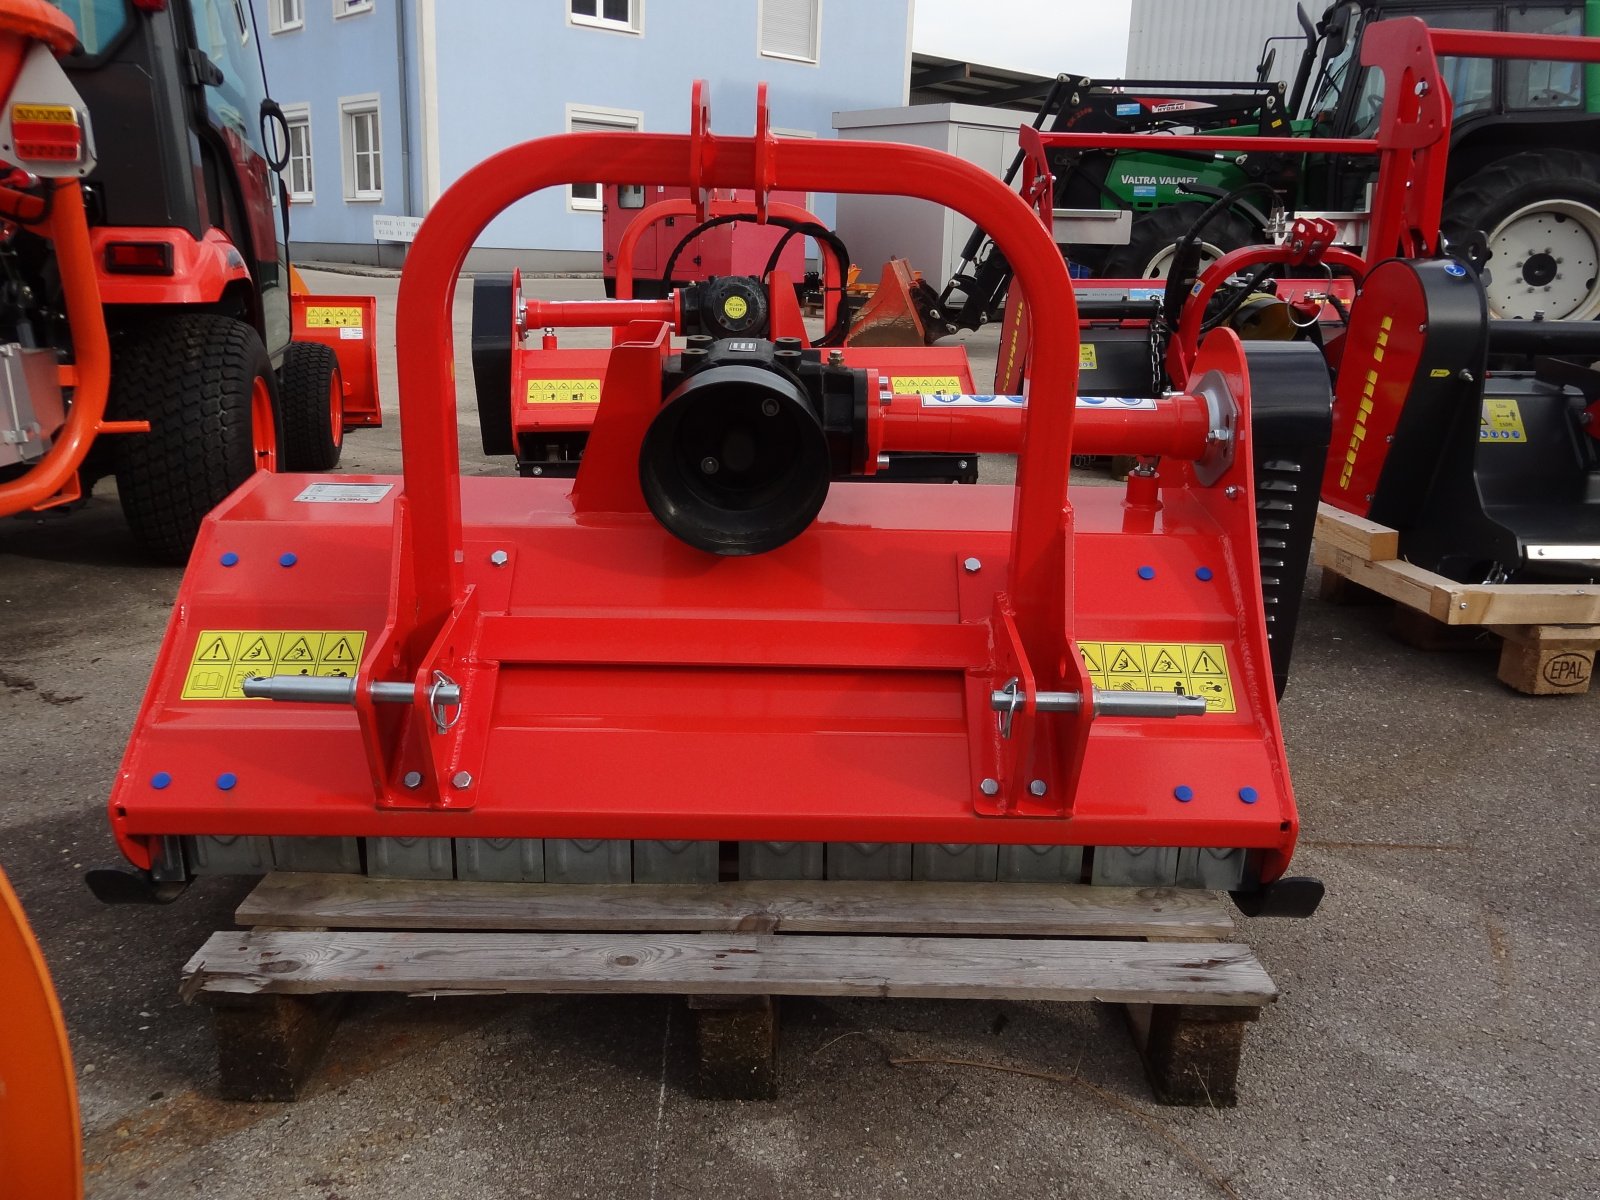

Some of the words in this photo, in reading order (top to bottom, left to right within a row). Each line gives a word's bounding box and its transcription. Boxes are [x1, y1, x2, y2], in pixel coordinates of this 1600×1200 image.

[1121, 174, 1157, 185] VALTRA
[1159, 176, 1199, 185] VALMET
[1550, 661, 1584, 679] EPAL
